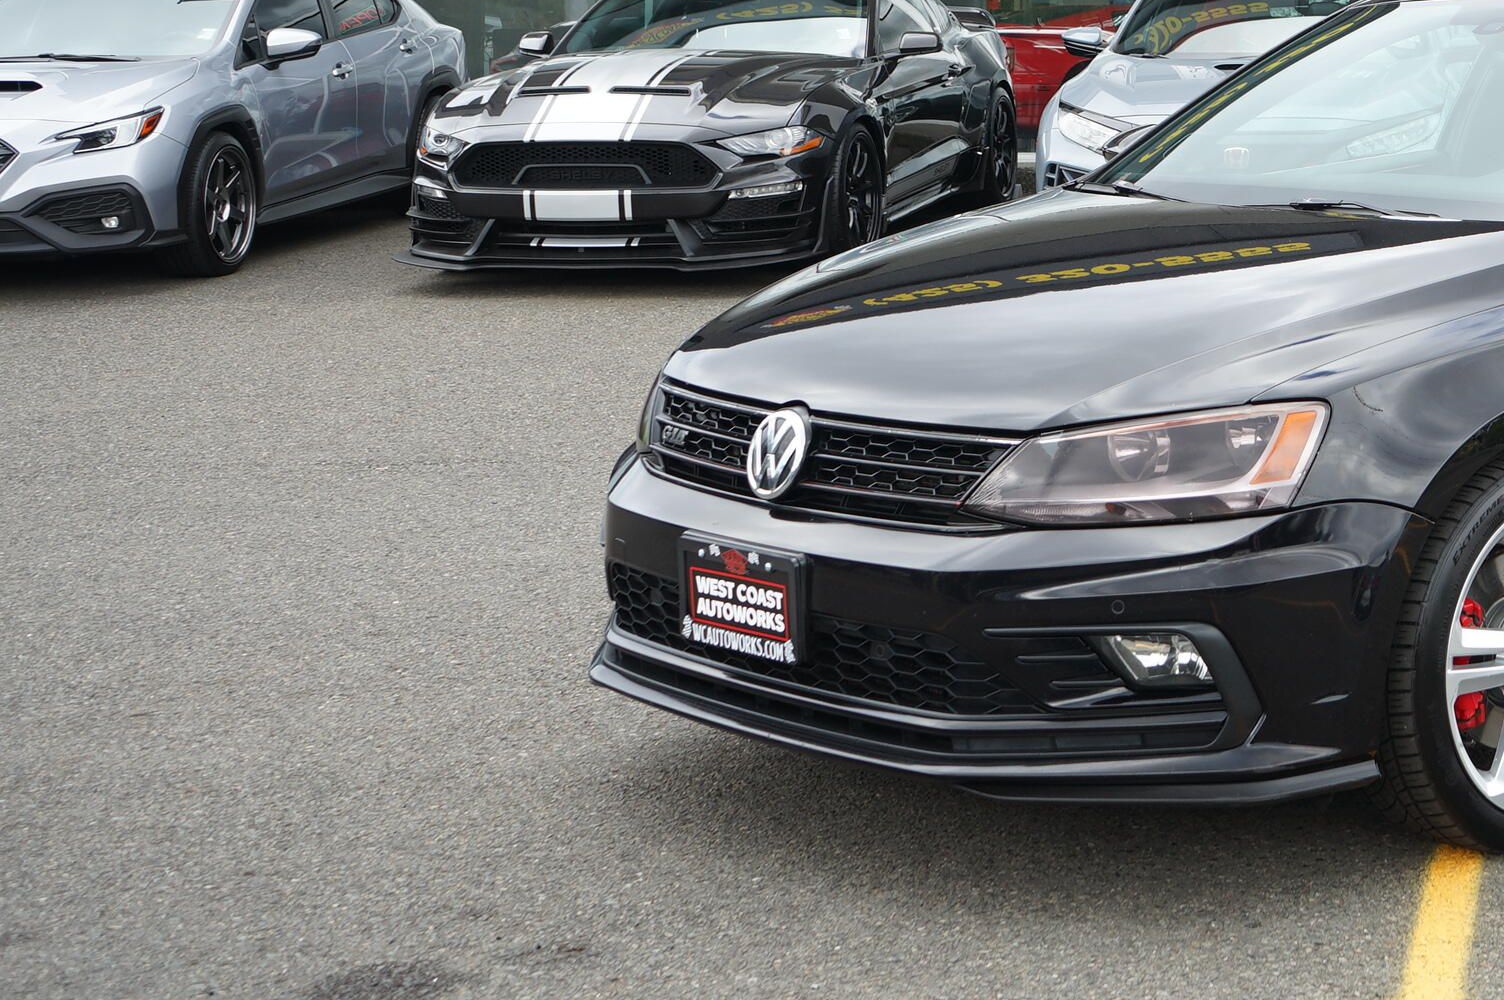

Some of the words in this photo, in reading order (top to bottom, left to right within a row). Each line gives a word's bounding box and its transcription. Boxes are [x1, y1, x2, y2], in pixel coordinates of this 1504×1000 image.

[695, 575, 735, 600] WEST
[736, 583, 784, 611] COAST
[696, 597, 786, 633] AUTOWORKS
[691, 622, 785, 662] WCAUTOWORKS.COM
